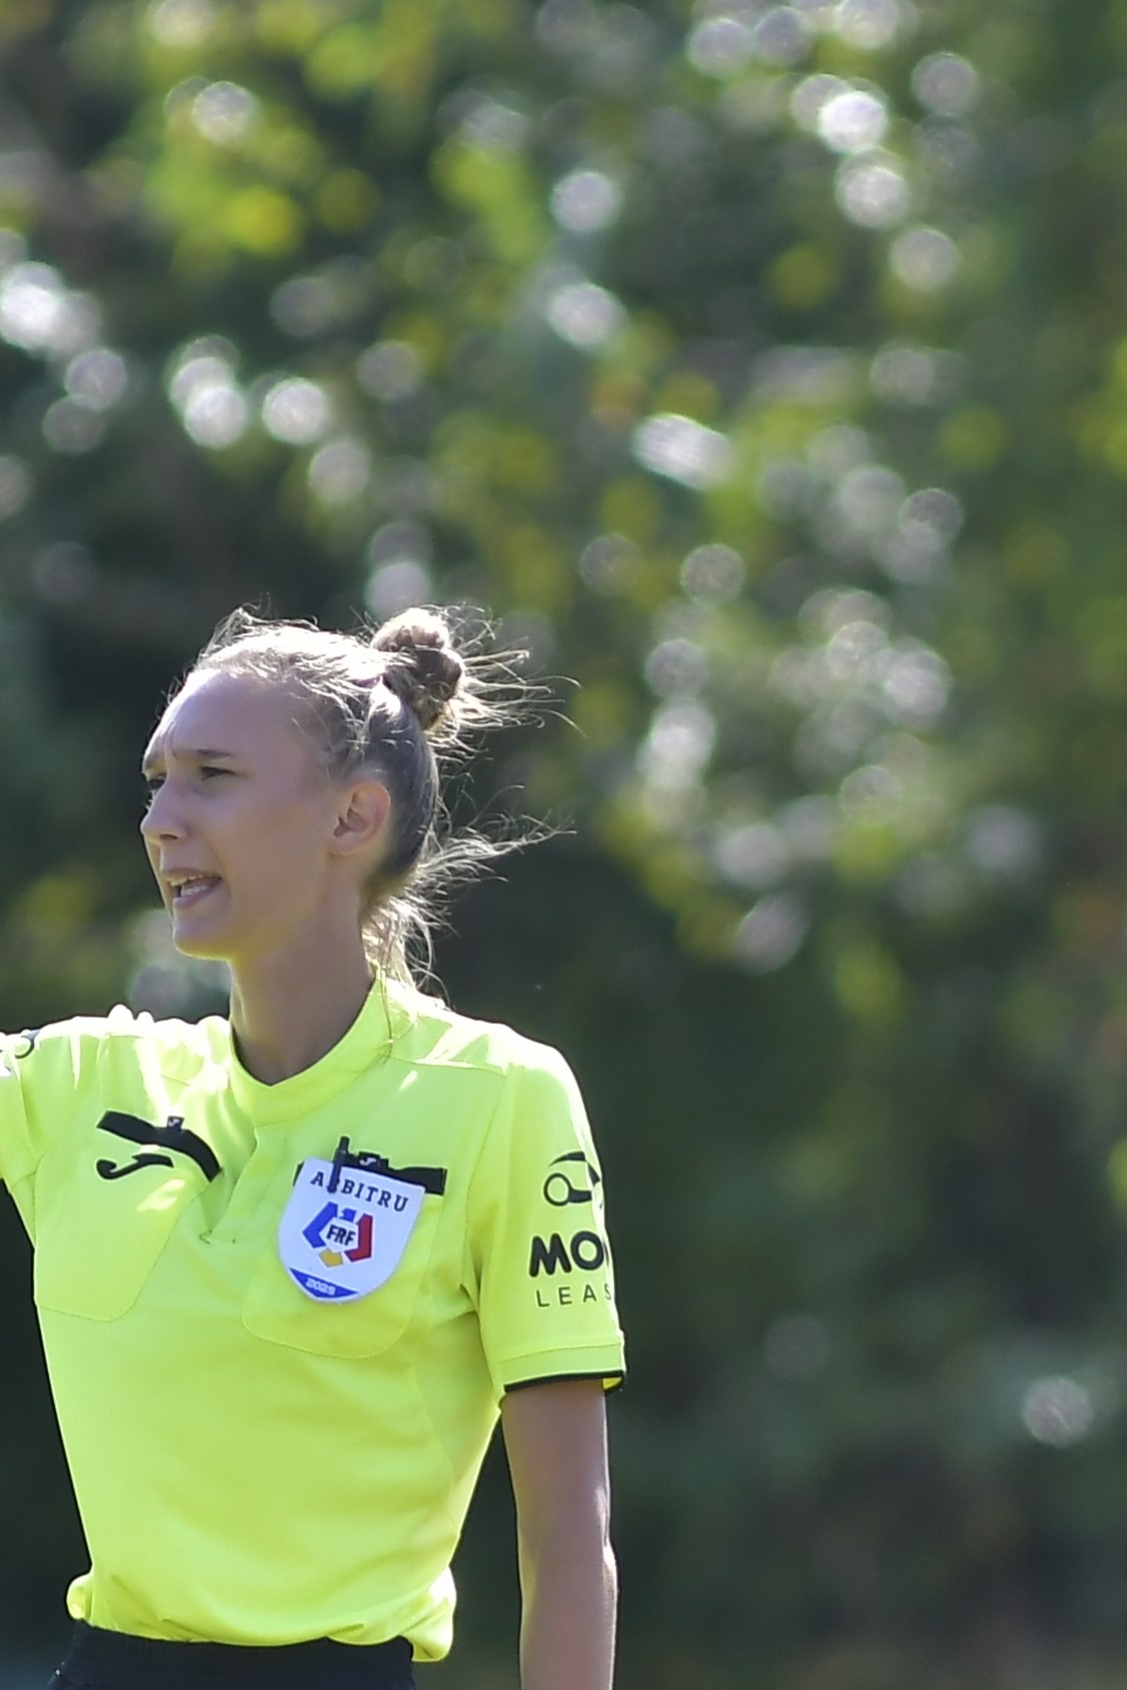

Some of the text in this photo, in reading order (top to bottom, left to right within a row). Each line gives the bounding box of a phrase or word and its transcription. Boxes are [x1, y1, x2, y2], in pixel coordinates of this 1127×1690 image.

[310, 1171, 409, 1212] ABITRU
[326, 1224, 356, 1246] FRF
[529, 1231, 609, 1278] MO
